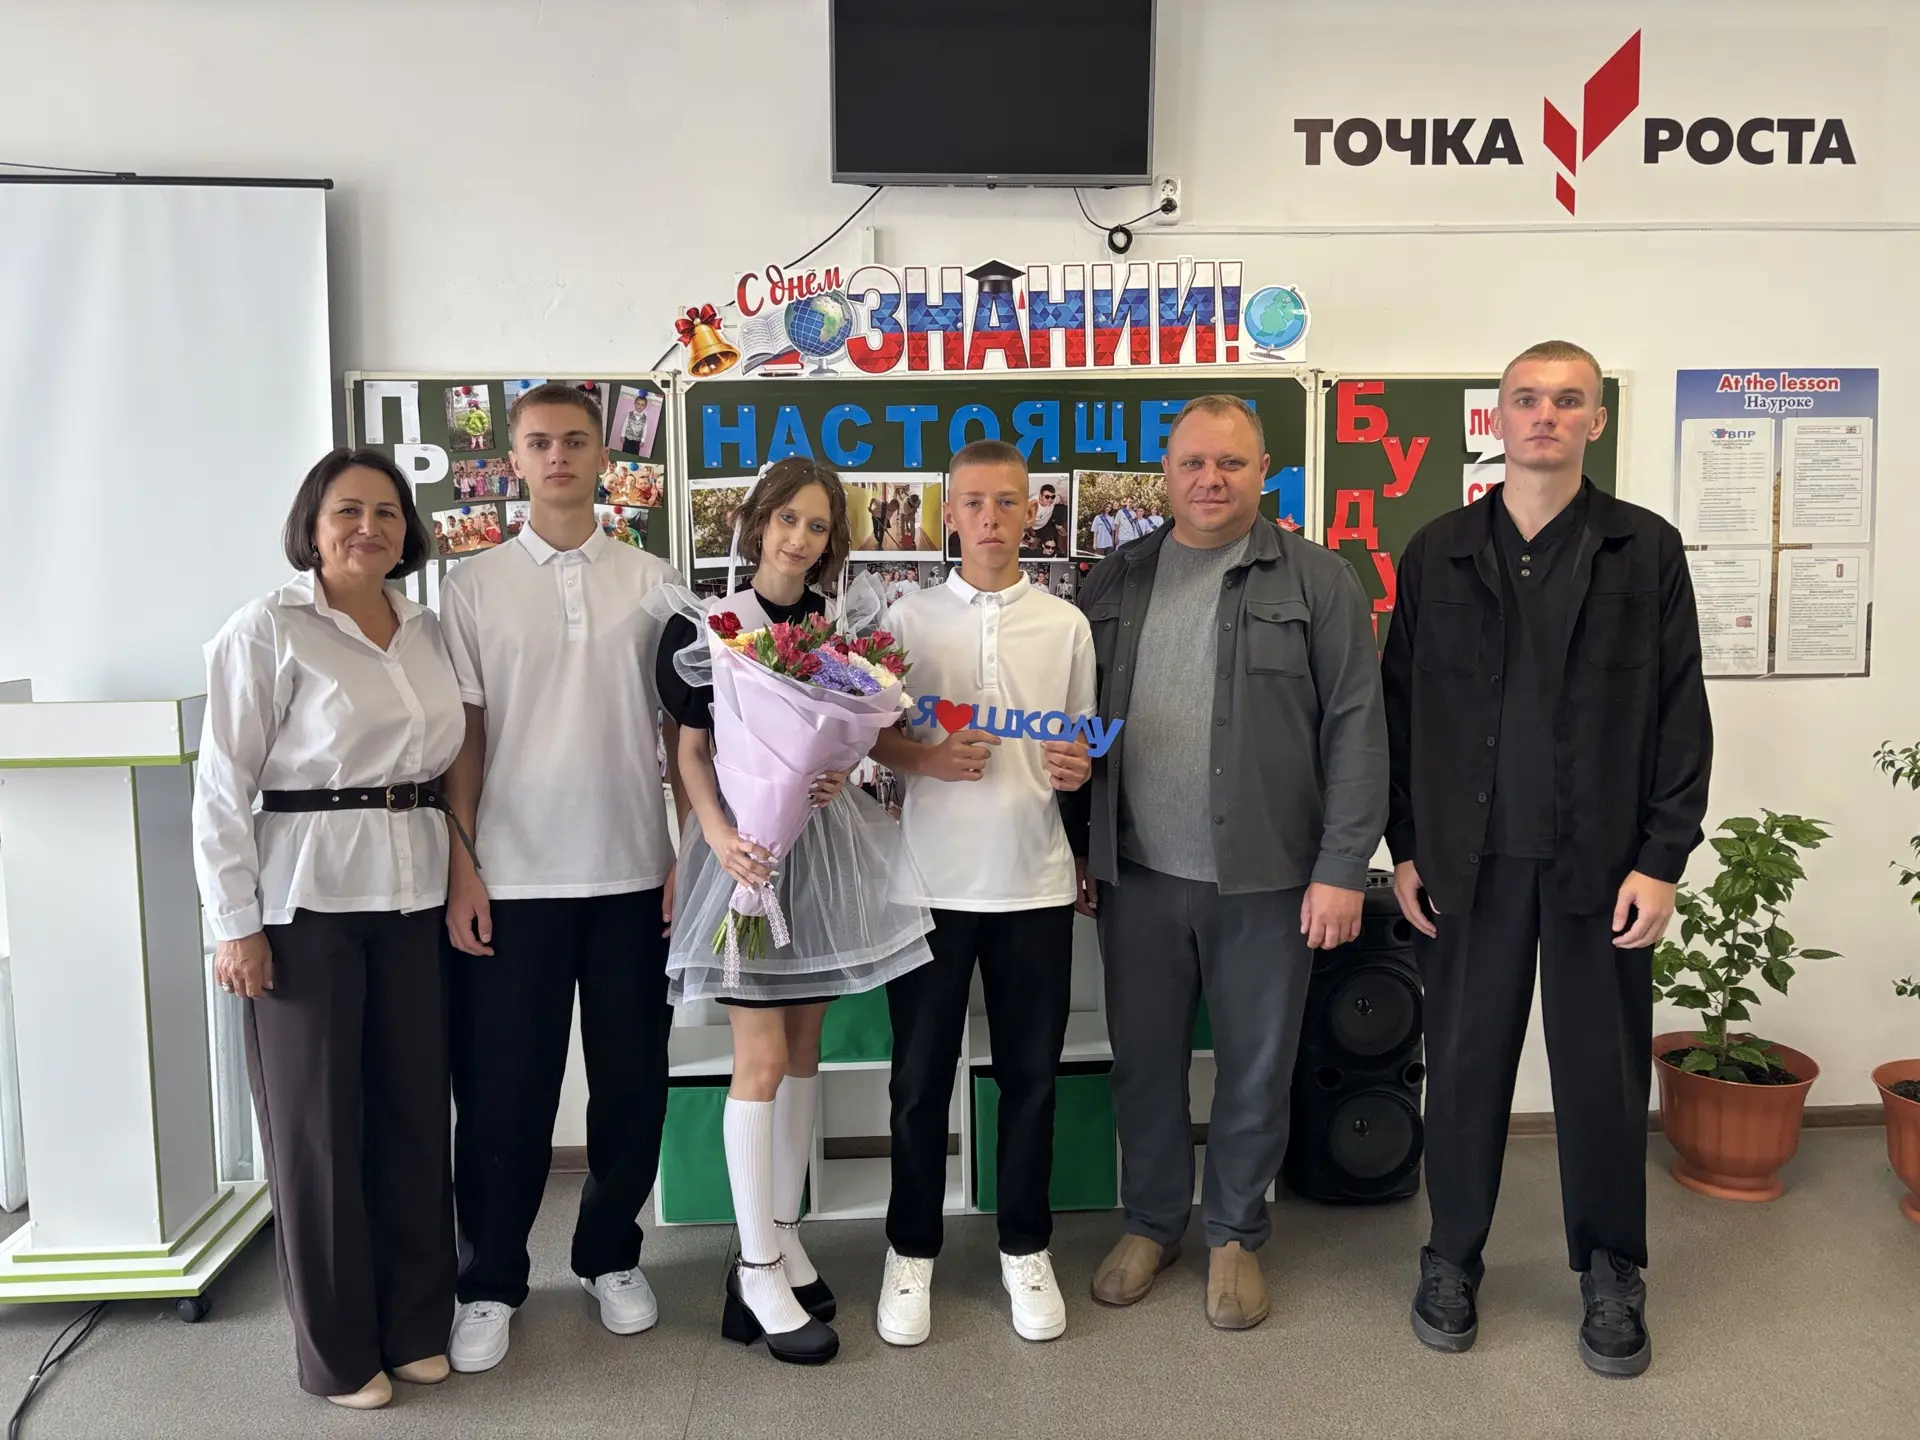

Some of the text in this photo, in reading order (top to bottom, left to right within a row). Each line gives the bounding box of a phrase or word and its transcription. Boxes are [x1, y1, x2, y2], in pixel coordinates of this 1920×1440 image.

[1294, 117, 1857, 166] ТОЧКА РОСТА
[737, 272, 764, 317] С
[1718, 373, 1840, 391] At the lesson
[1746, 395, 1812, 412] На уроке
[702, 400, 1256, 468] НАСТОЯЩЕ
[1728, 430, 1756, 439] ВПР
